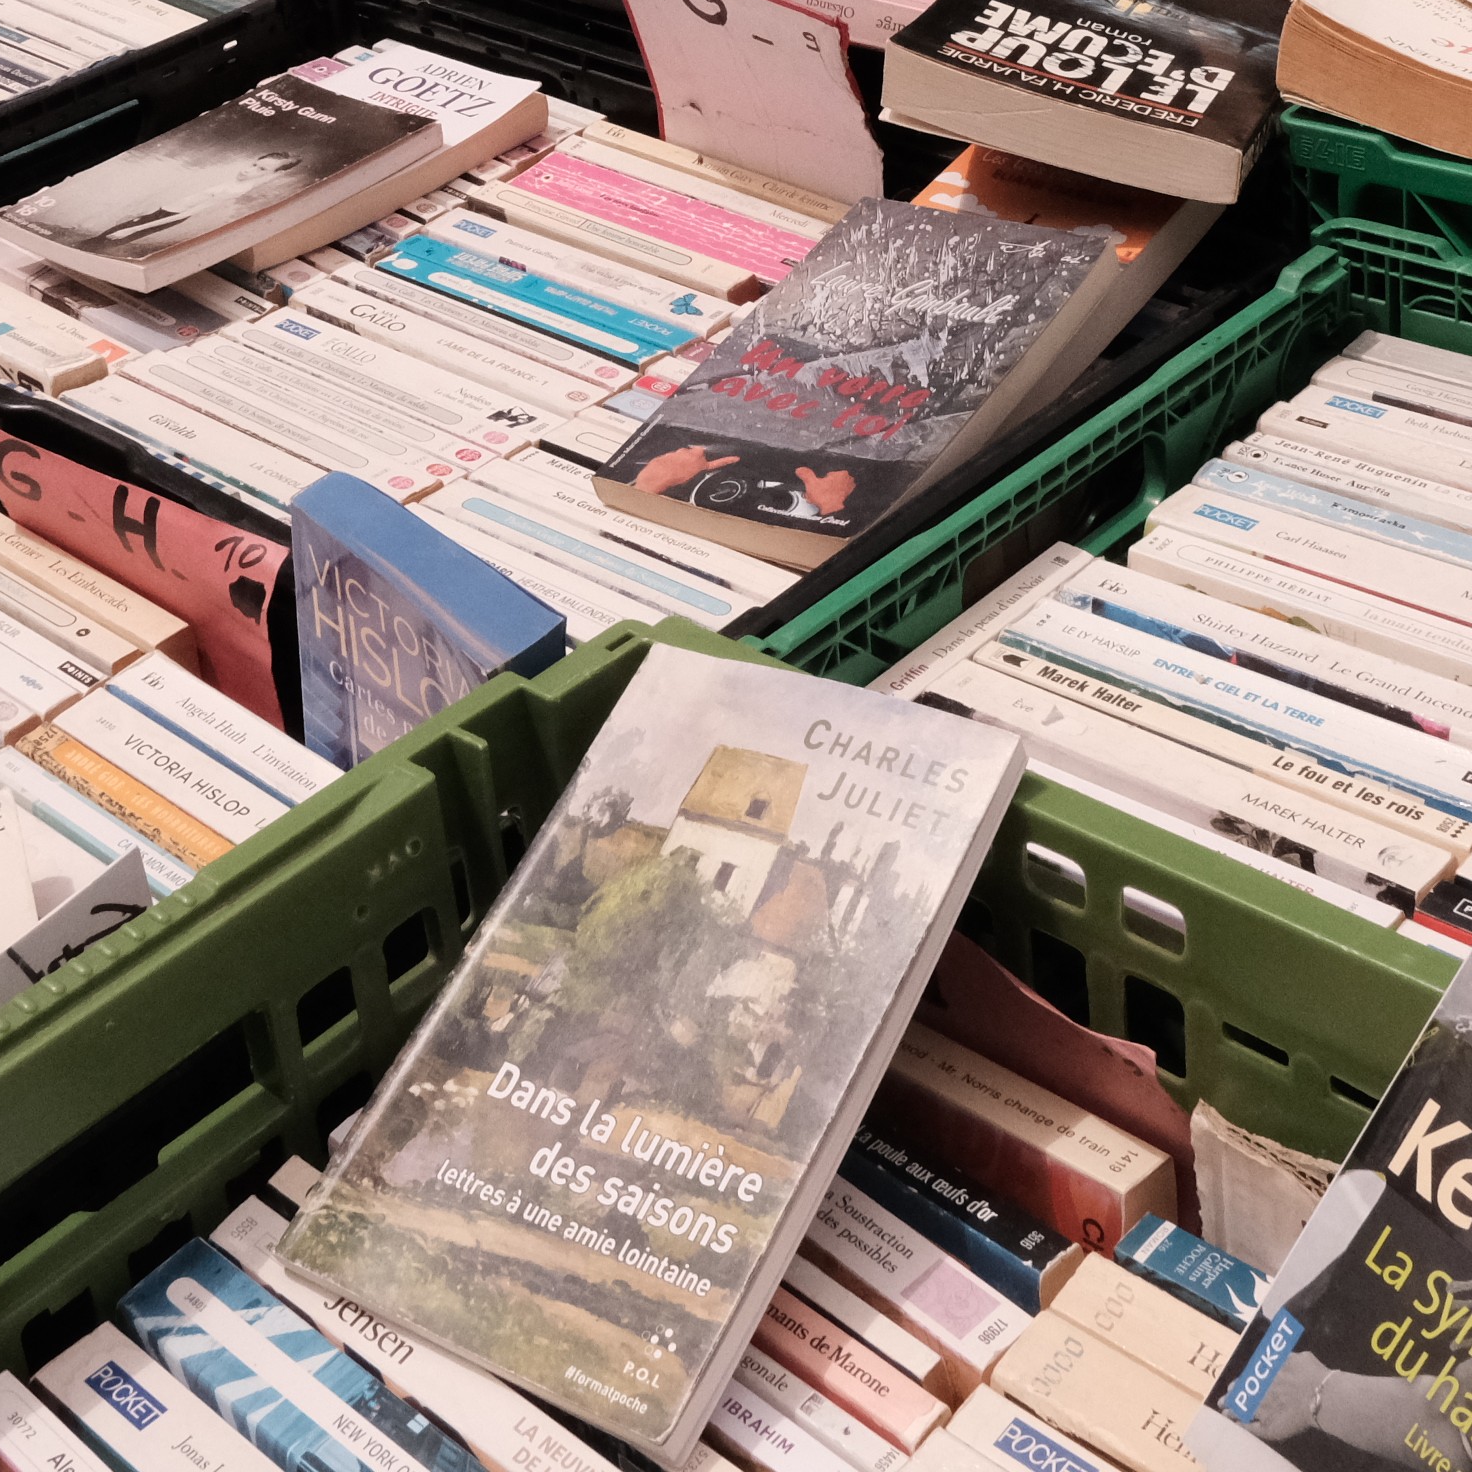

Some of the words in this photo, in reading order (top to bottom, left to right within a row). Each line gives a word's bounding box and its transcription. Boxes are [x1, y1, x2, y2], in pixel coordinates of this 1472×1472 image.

[950, 27, 1134, 96] LOUP
[1077, 17, 1151, 46] roman
[368, 65, 496, 120] GOETZ
[417, 62, 493, 91] ADRIEN
[937, 45, 1047, 88] FAJARDIE
[1140, 75, 1224, 114] LE
[238, 97, 273, 119] Pluie
[257, 88, 298, 112] Kirsty
[297, 105, 336, 124] Gunn
[1079, 89, 1199, 127] FREDERIC
[111, 485, 166, 572] H
[213, 535, 267, 572] 10
[1192, 612, 1246, 648] Shirley
[1250, 630, 1319, 666] Hazzard
[1330, 659, 1351, 677] Le
[1354, 667, 1407, 698] Grand
[124, 733, 194, 787] VICTORIA
[196, 778, 252, 817] HISLOP
[175, 693, 215, 726] Angela
[213, 716, 249, 747] Huth
[250, 743, 318, 793] L'invitation
[802, 717, 970, 796] CHARLES
[1036, 664, 1087, 696] Marek
[1092, 681, 1142, 714] Halter
[1272, 753, 1294, 772] Le
[1292, 759, 1327, 787] fou
[1330, 776, 1349, 793] et
[1355, 783, 1382, 808] les
[1387, 796, 1425, 824] rois
[817, 770, 951, 832] JULIET
[1242, 790, 1298, 826] MAREK
[1301, 811, 1366, 850] HALTER
[486, 1063, 577, 1125] Dans
[578, 1111, 616, 1147] la
[619, 1124, 766, 1206] lumière
[437, 1158, 505, 1209] lettres
[505, 1181, 522, 1215] à
[523, 1197, 562, 1236] une
[564, 1222, 617, 1269] amie
[619, 1241, 712, 1298] lointaine
[528, 1141, 596, 1195] des
[602, 1173, 737, 1256] saisons
[1364, 1225, 1414, 1292] La
[623, 1360, 661, 1390] P.O.L
[1234, 1316, 1297, 1416] POCKET
[1370, 1316, 1429, 1383] du
[564, 1364, 648, 1416] #formatpoche
